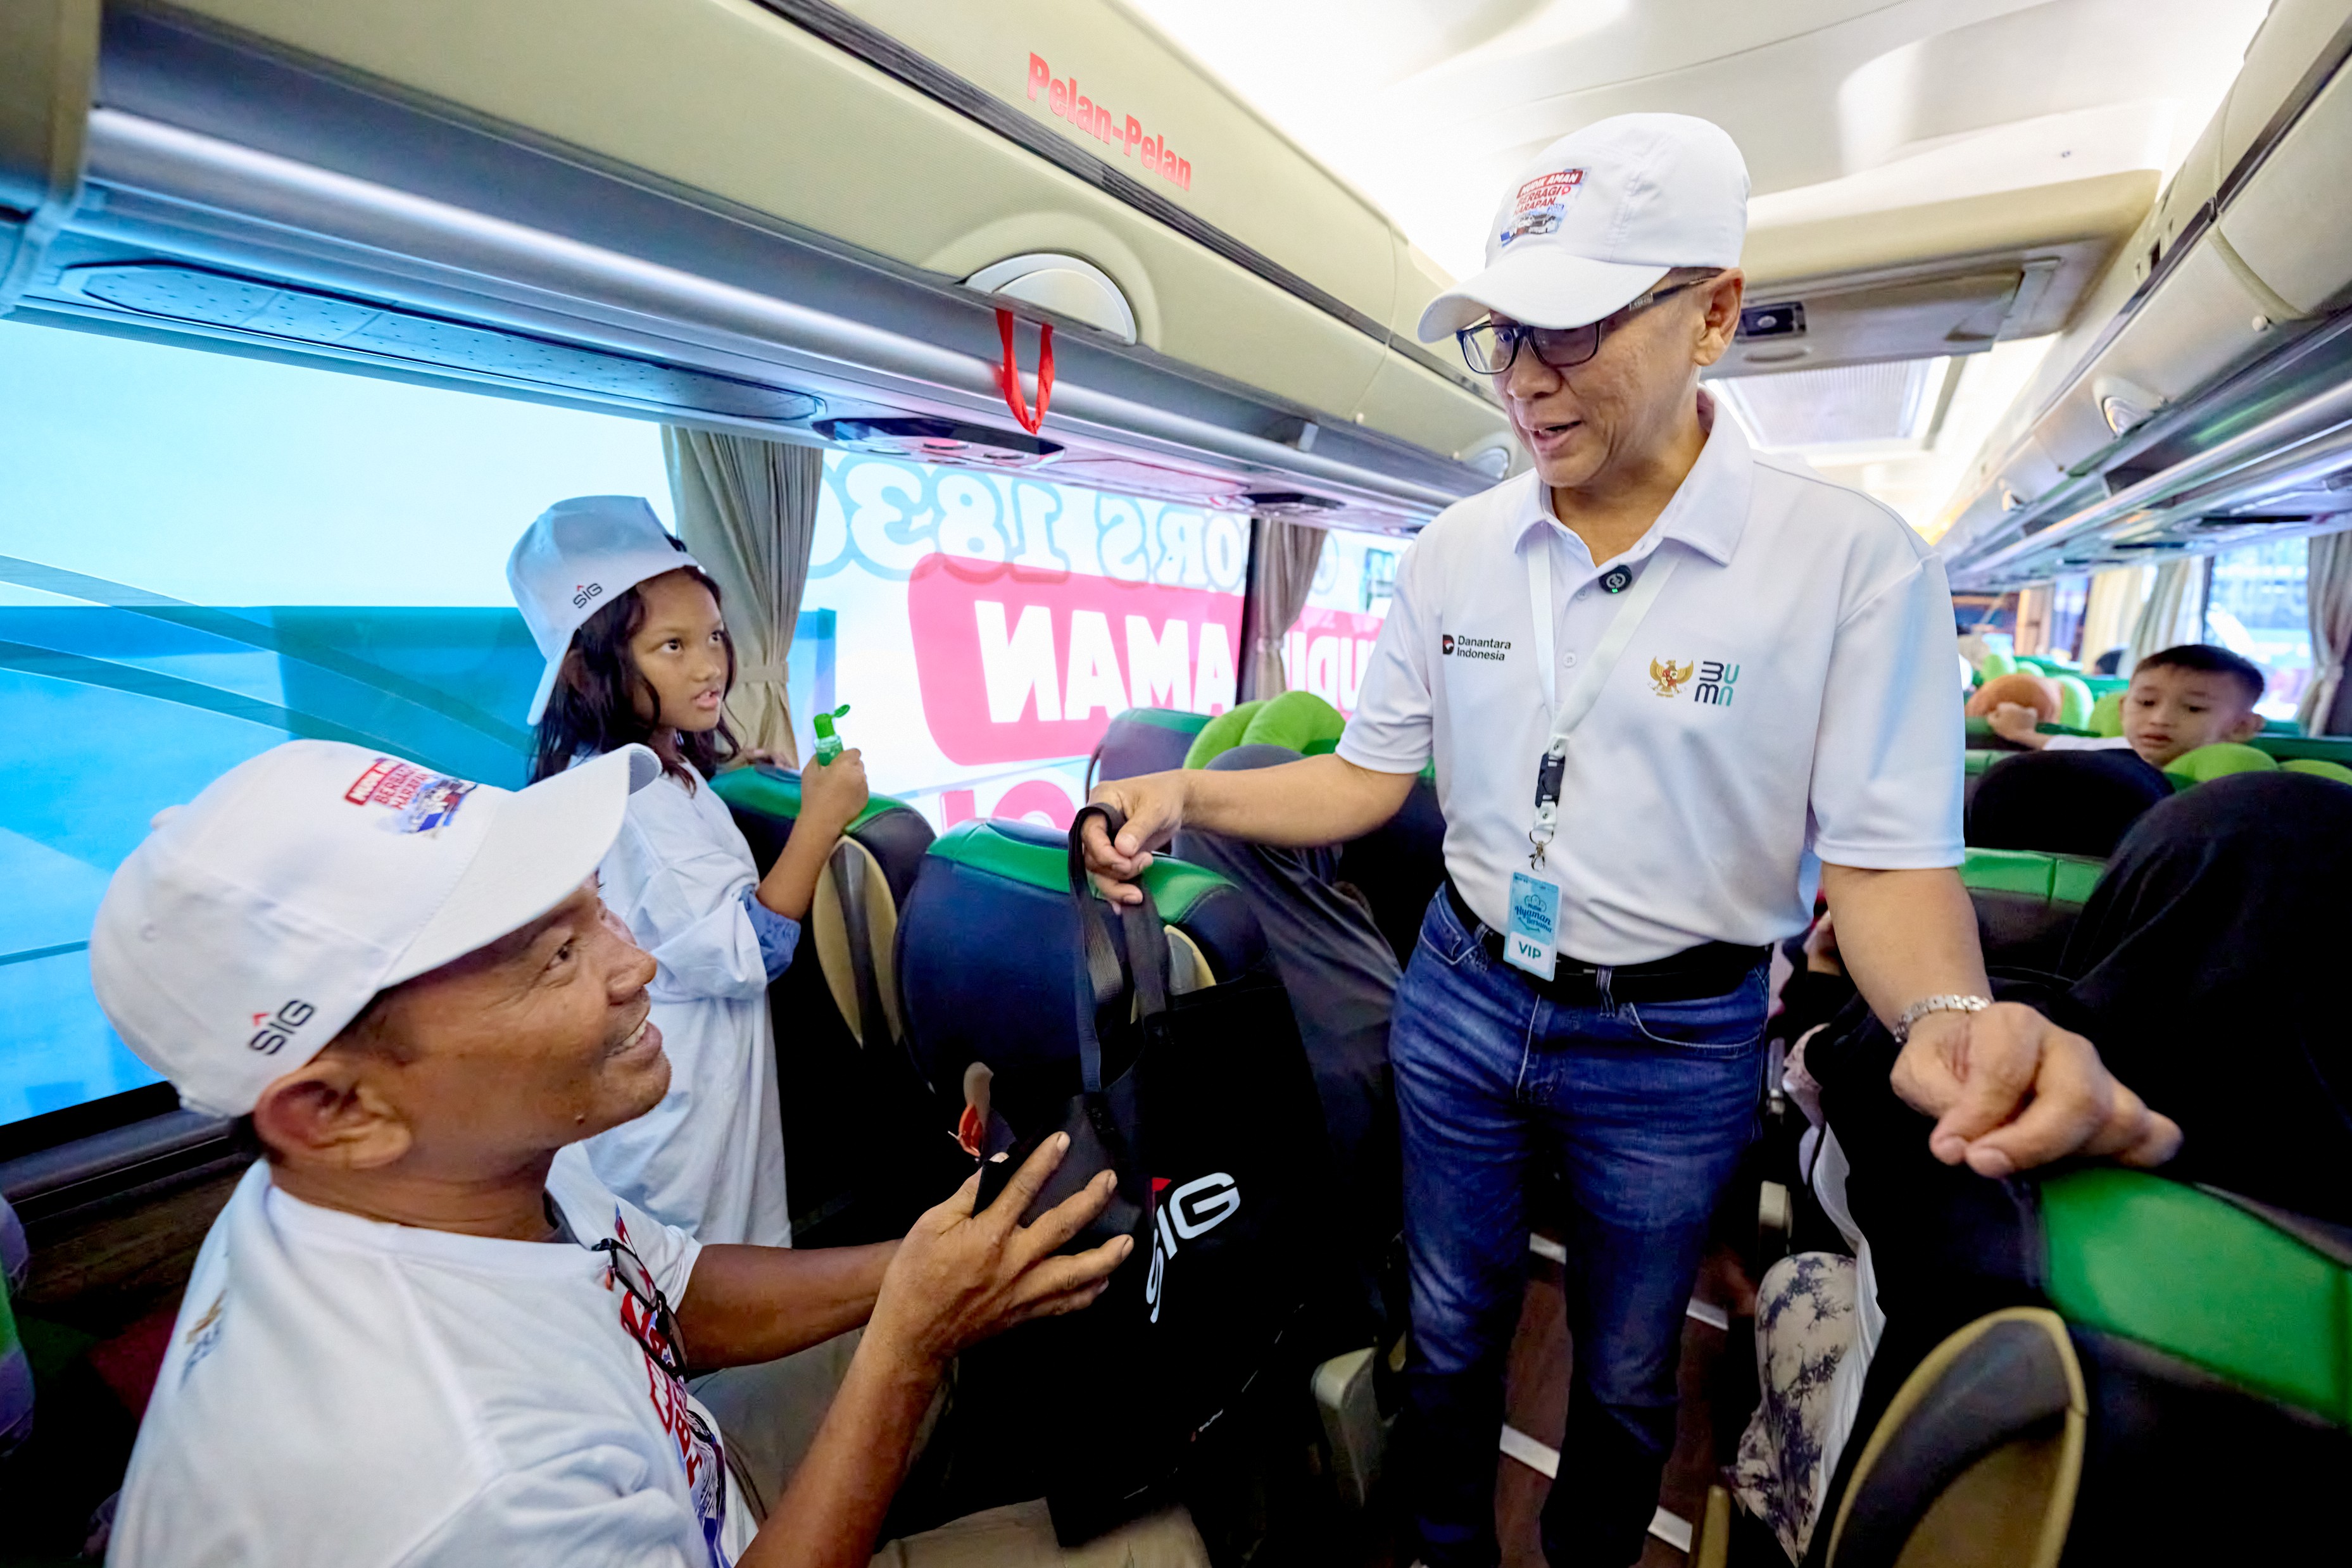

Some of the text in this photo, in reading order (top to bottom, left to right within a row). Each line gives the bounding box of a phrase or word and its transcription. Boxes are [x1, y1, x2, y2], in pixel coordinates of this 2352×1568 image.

[1027, 51, 1192, 192] Pelan-Pelan
[1519, 186, 1562, 204] BERBAGI
[1520, 173, 1580, 196] MUDIK AMAN
[573, 583, 602, 609] SIG
[1458, 635, 1511, 649] Danantara
[1457, 647, 1505, 661] Indonesia
[1514, 905, 1551, 925] Nyaman
[1518, 941, 1541, 960] VIP
[249, 1000, 315, 1055] SIG
[1146, 1172, 1241, 1324] SIG
